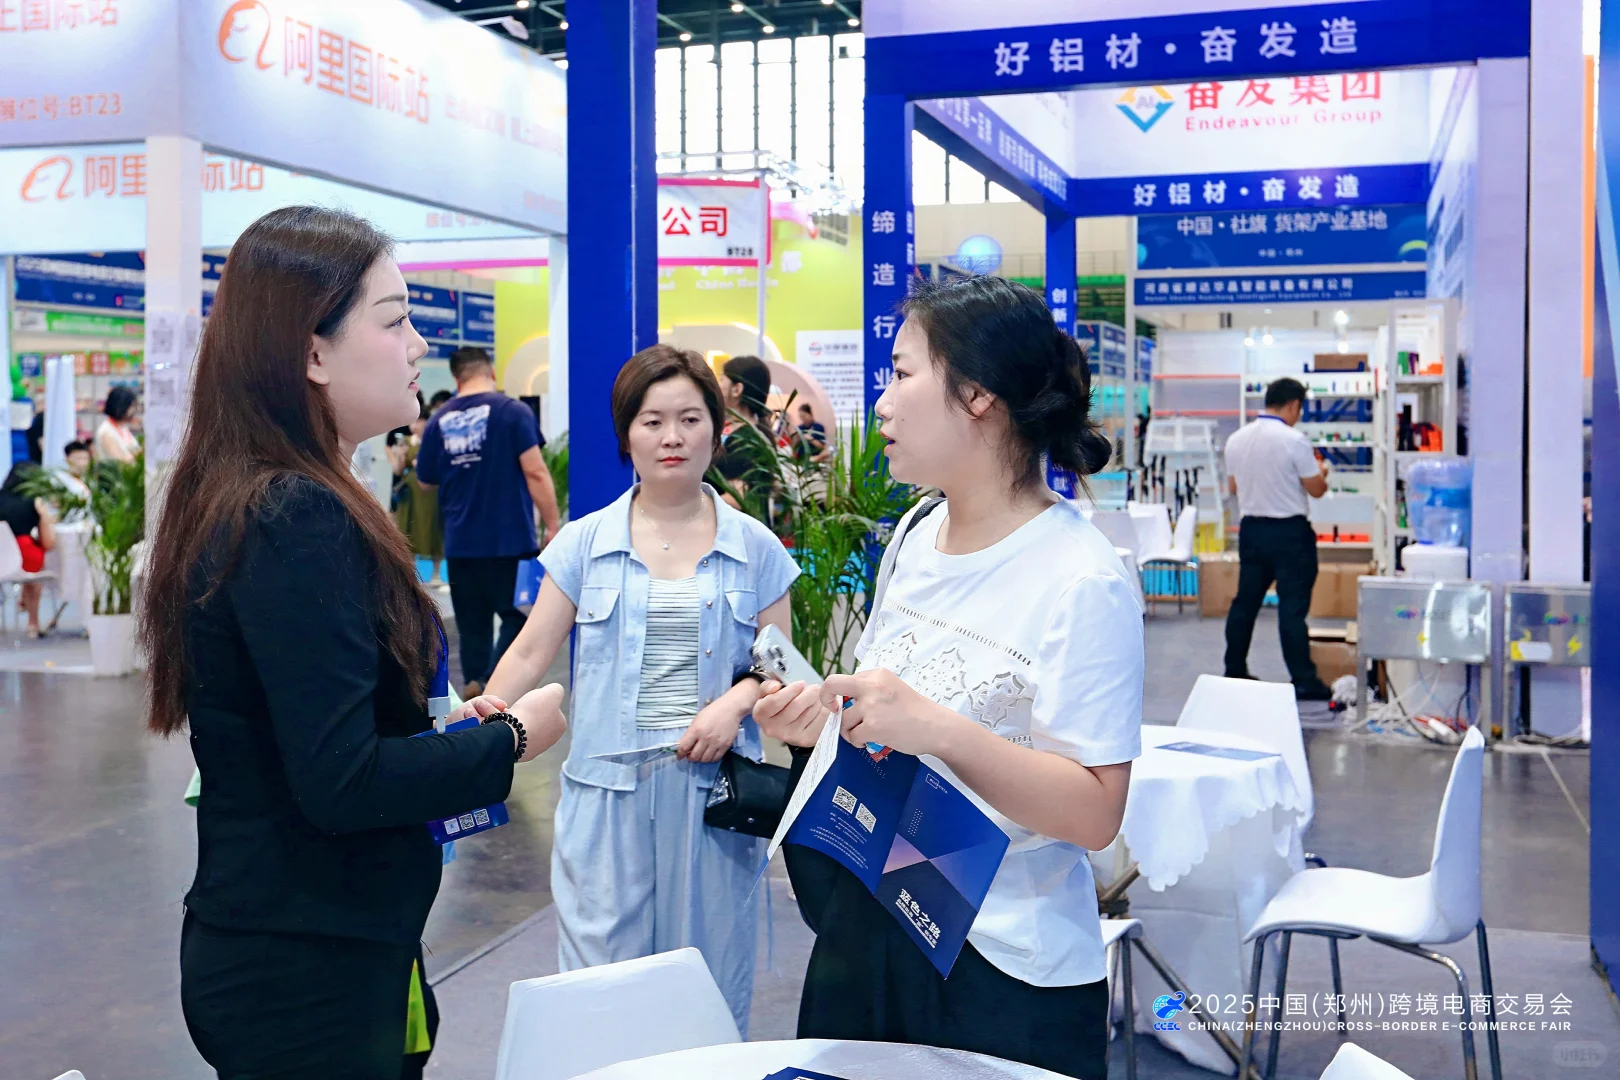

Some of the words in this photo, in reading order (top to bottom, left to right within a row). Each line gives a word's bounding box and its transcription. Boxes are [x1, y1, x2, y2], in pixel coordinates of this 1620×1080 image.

[284, 16, 429, 124] 阿里国际站
[1185, 114, 1300, 131] Endeavour
[1314, 109, 1382, 124] Group
[84, 153, 264, 198] 阿里际站
[662, 206, 728, 237] 公司
